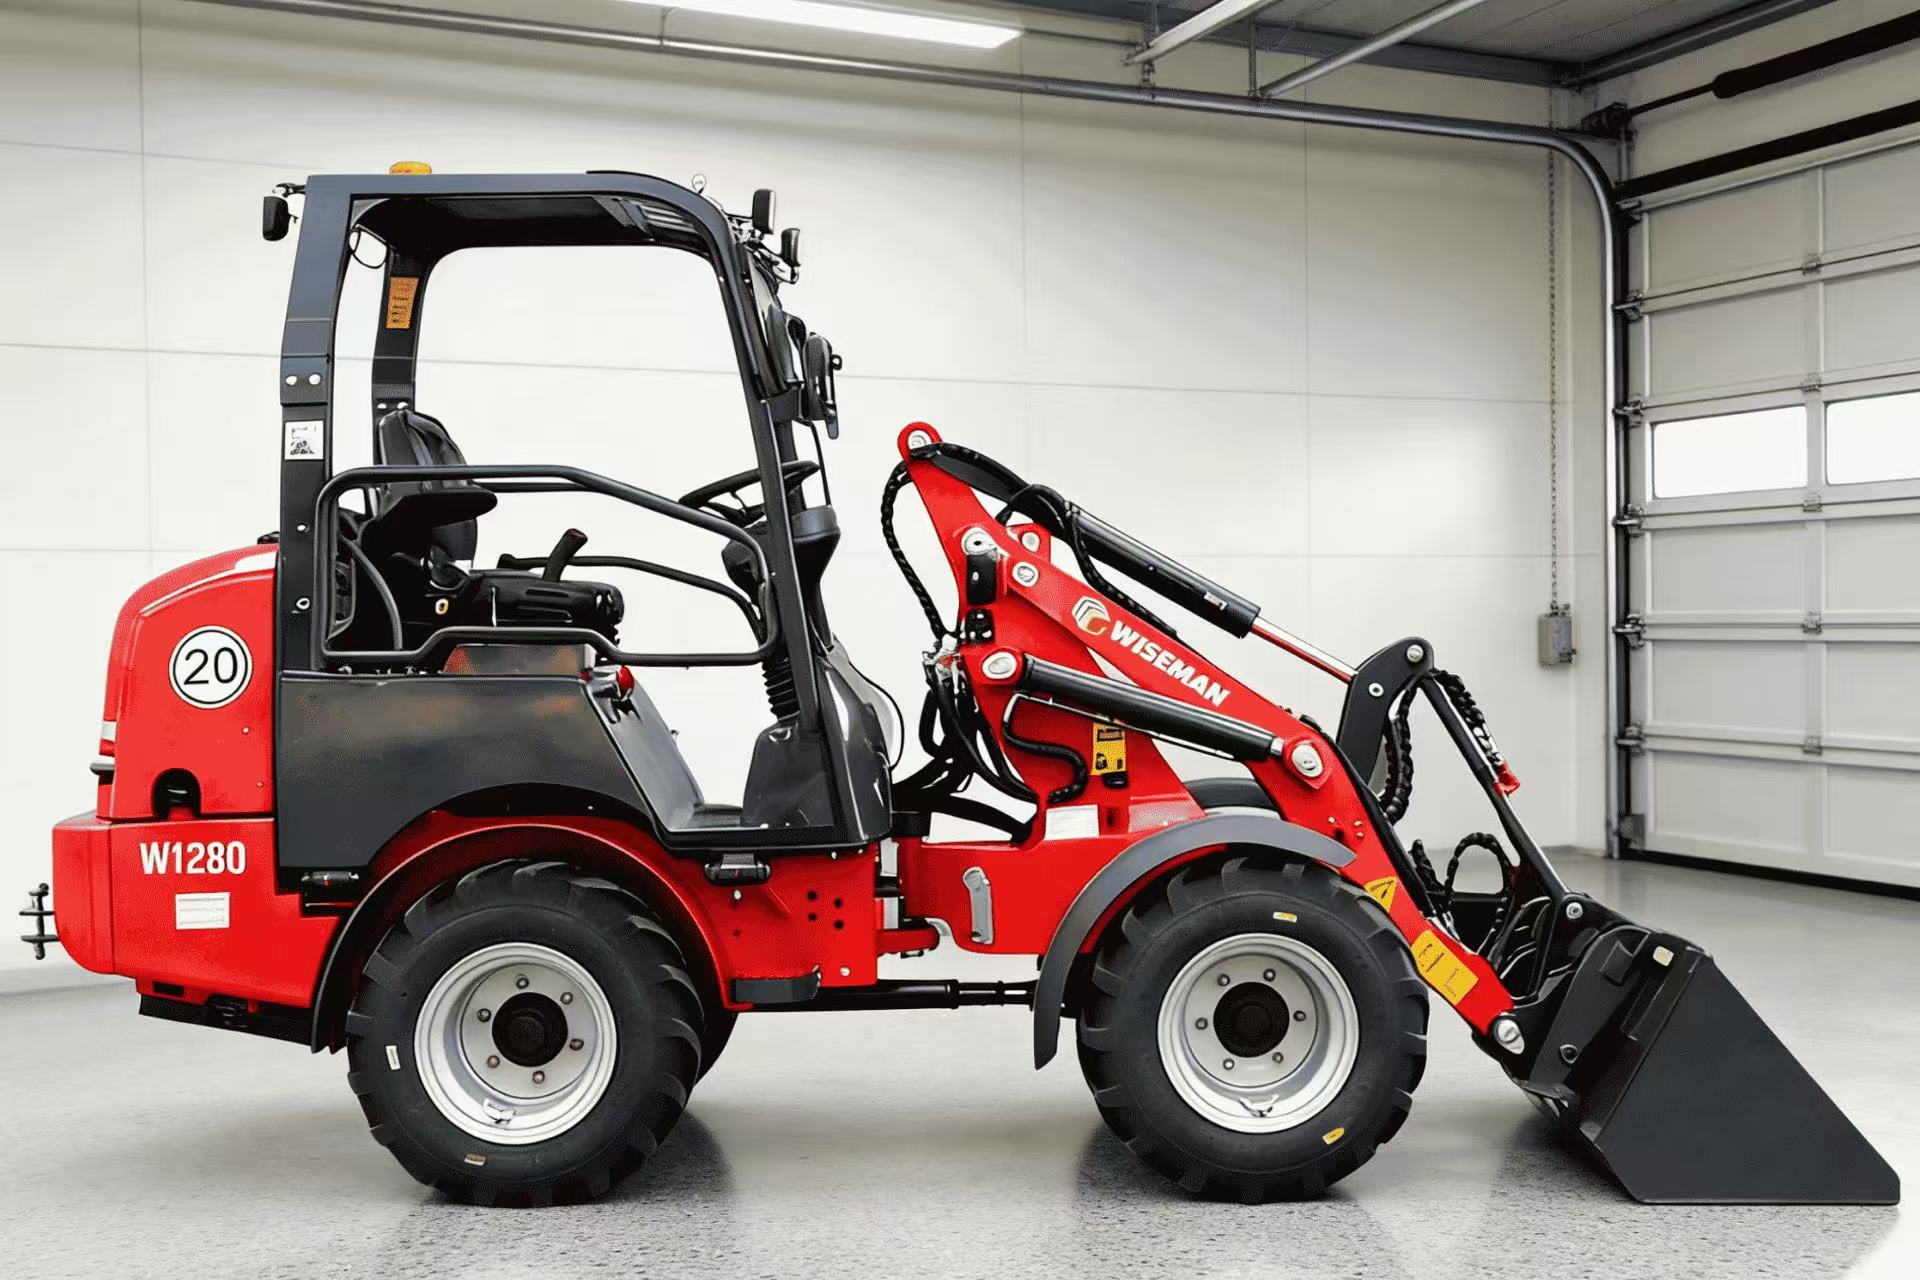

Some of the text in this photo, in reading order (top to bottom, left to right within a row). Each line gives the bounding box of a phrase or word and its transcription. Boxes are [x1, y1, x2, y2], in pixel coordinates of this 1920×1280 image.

[184, 647, 237, 684] 20
[1111, 621, 1230, 706] WISEMAN
[139, 841, 246, 875] W1280
